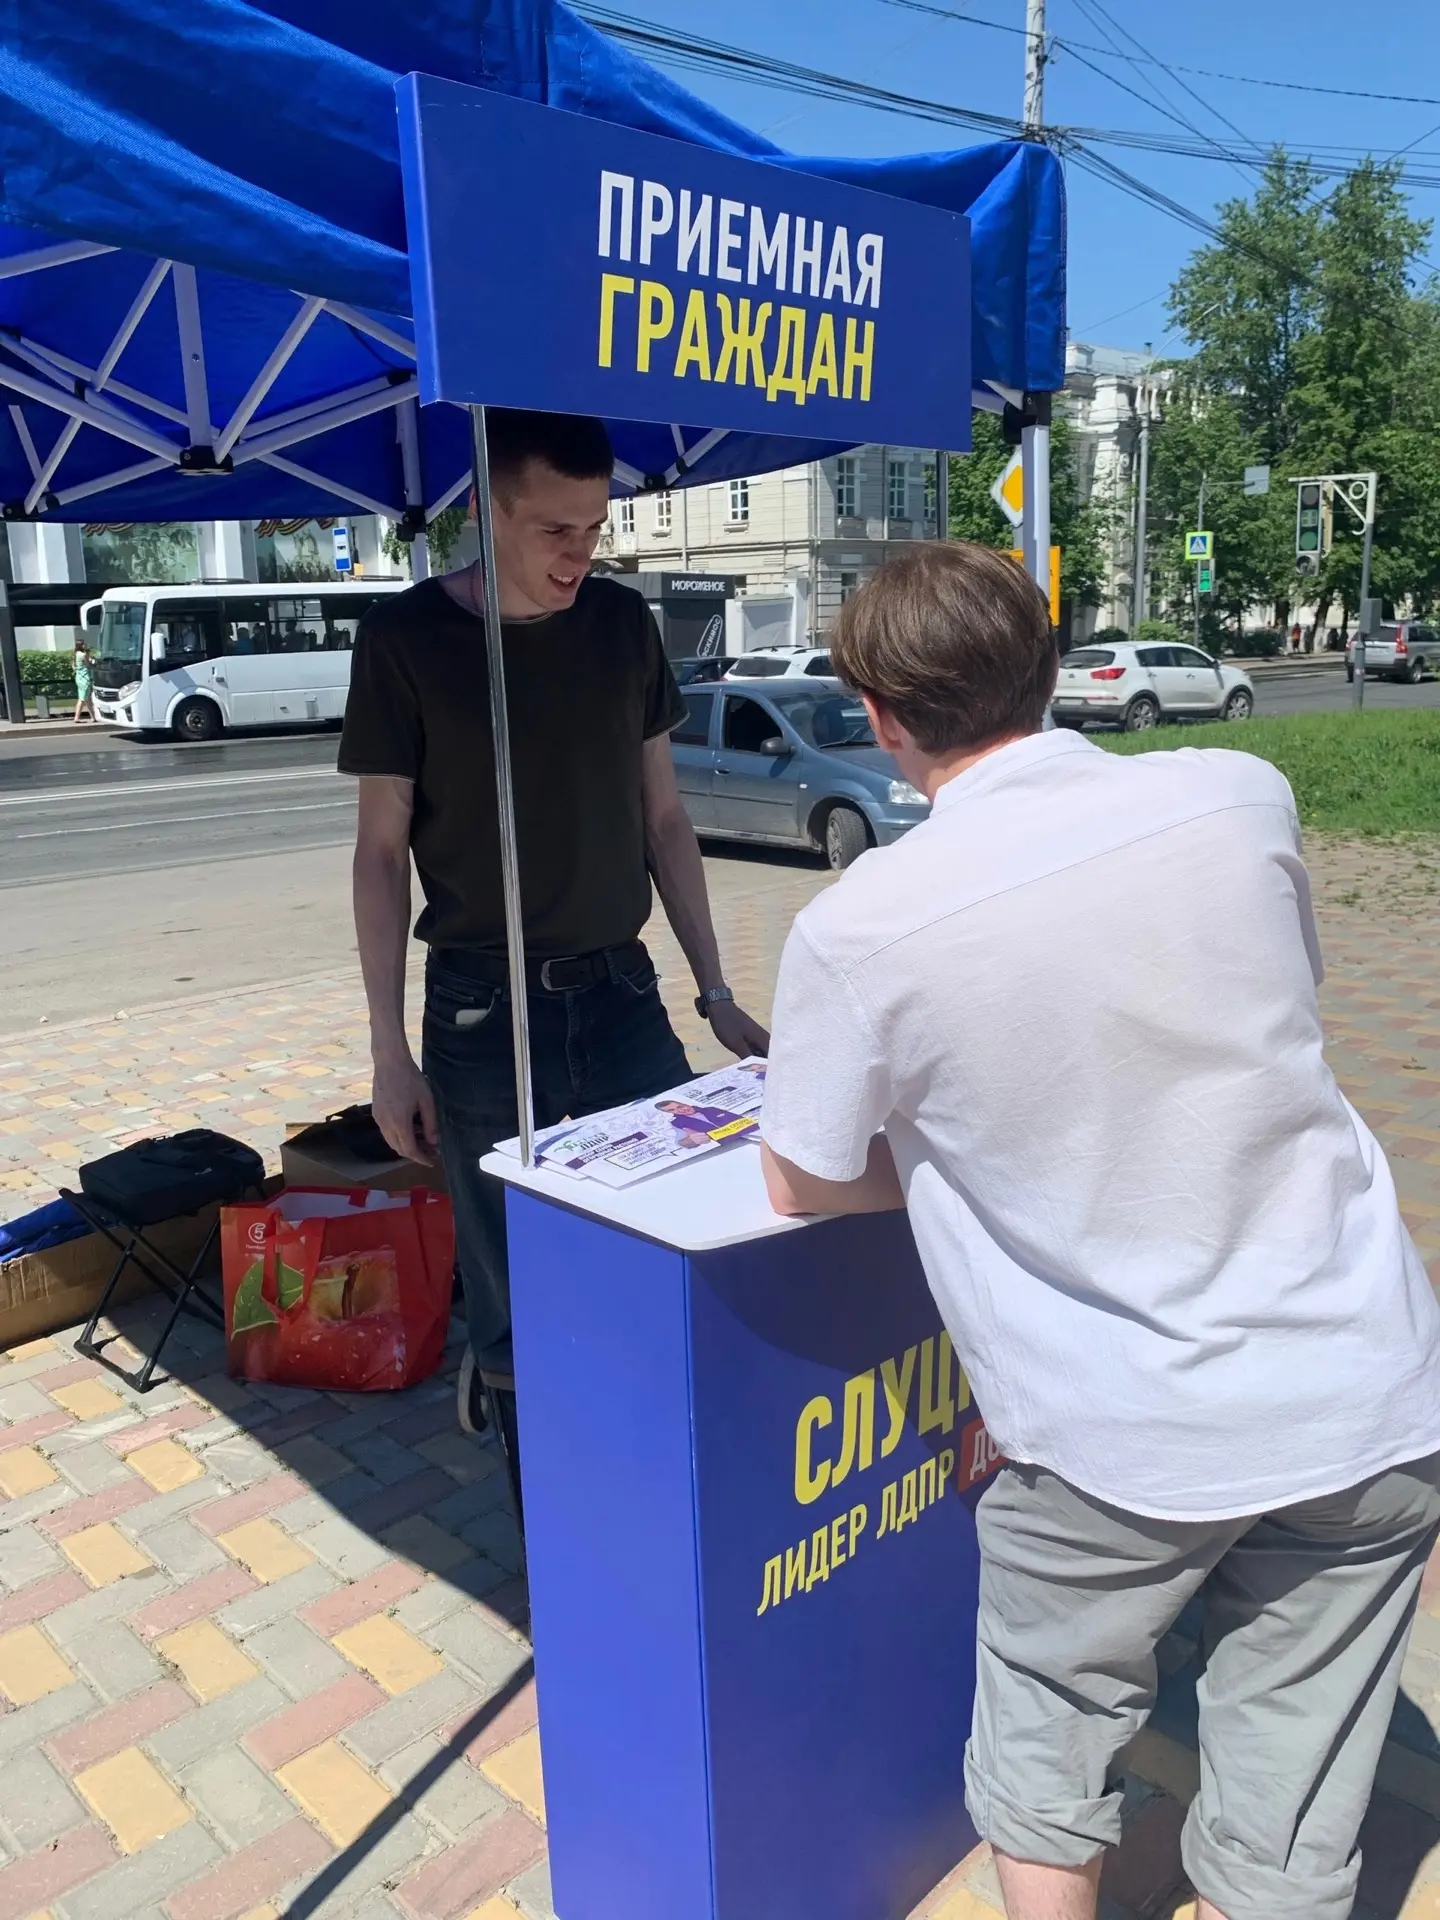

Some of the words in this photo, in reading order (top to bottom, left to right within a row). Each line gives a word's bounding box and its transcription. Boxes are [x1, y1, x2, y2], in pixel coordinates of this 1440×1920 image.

[598, 170, 884, 309] ПРИЕМНАЯ
[598, 273, 875, 406] ГРАЖДАН
[671, 580, 726, 592] МОРОЖЕНОЕ
[757, 1503, 868, 1616] ЛИДЕР
[876, 1448, 955, 1540] ЛДПР
